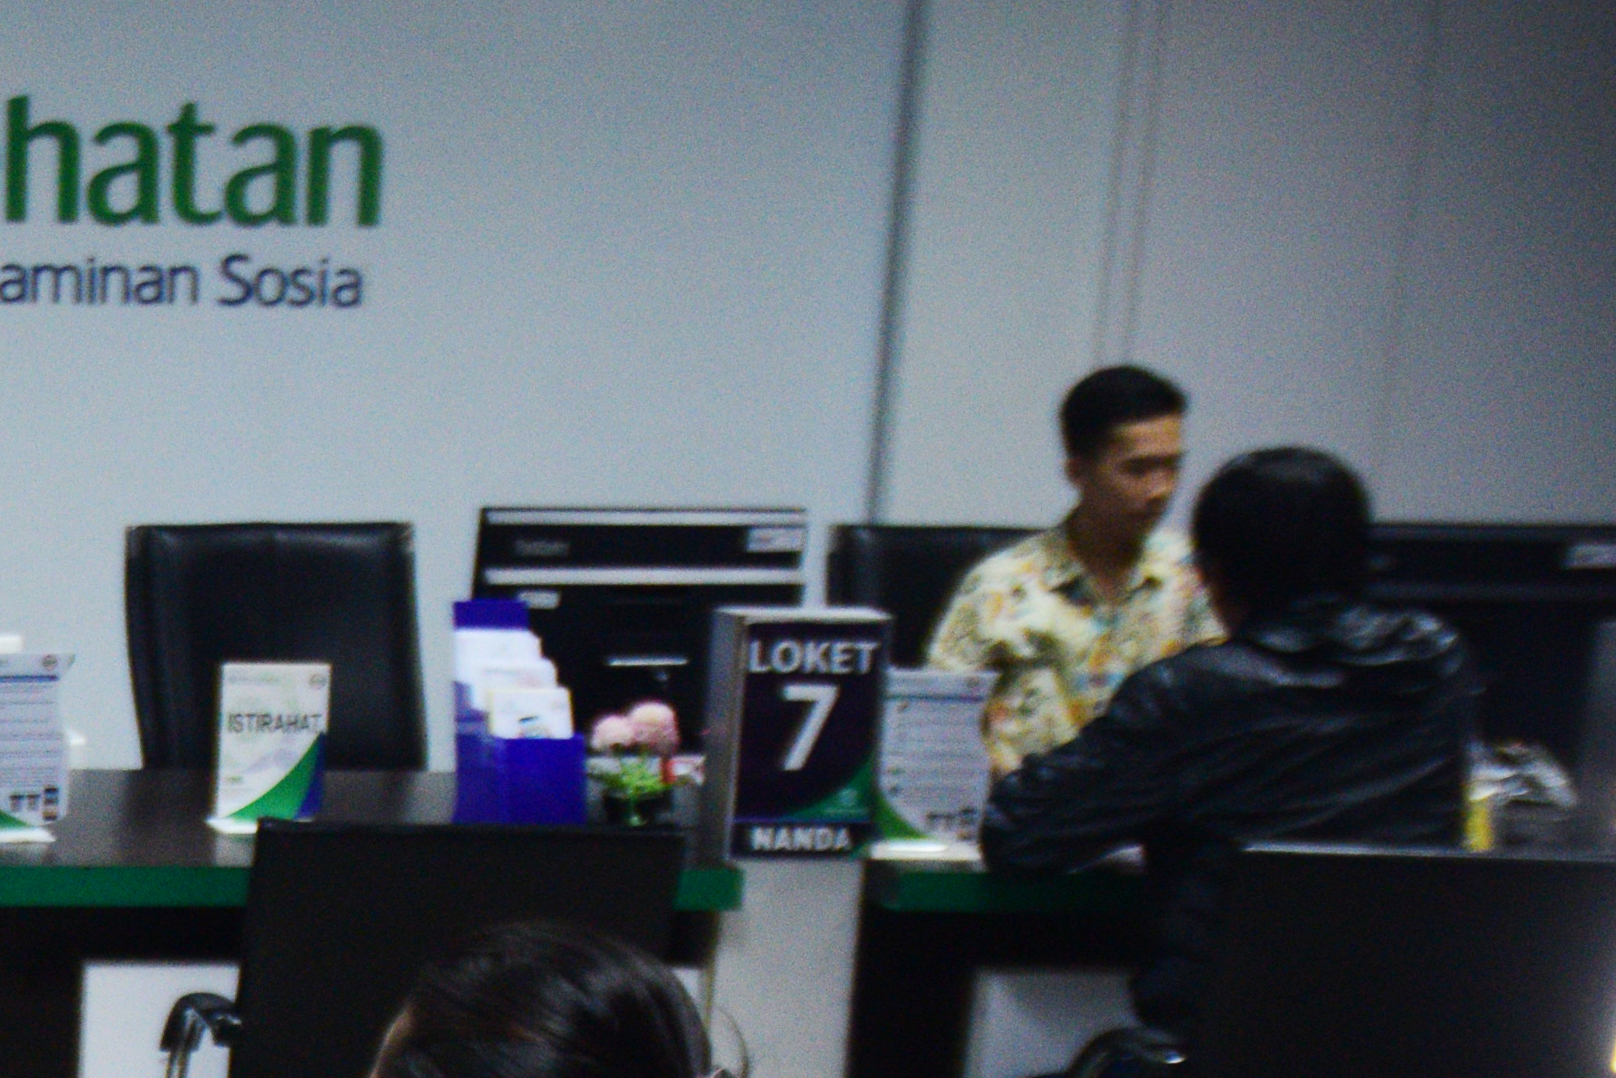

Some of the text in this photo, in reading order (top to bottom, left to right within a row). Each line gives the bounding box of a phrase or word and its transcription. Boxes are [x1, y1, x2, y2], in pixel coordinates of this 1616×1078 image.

[218, 253, 364, 307] Sosia
[748, 640, 879, 674] LOKET
[228, 713, 323, 733] ISTIRAHAT
[783, 684, 838, 771] 7
[751, 826, 852, 850] NANDA
